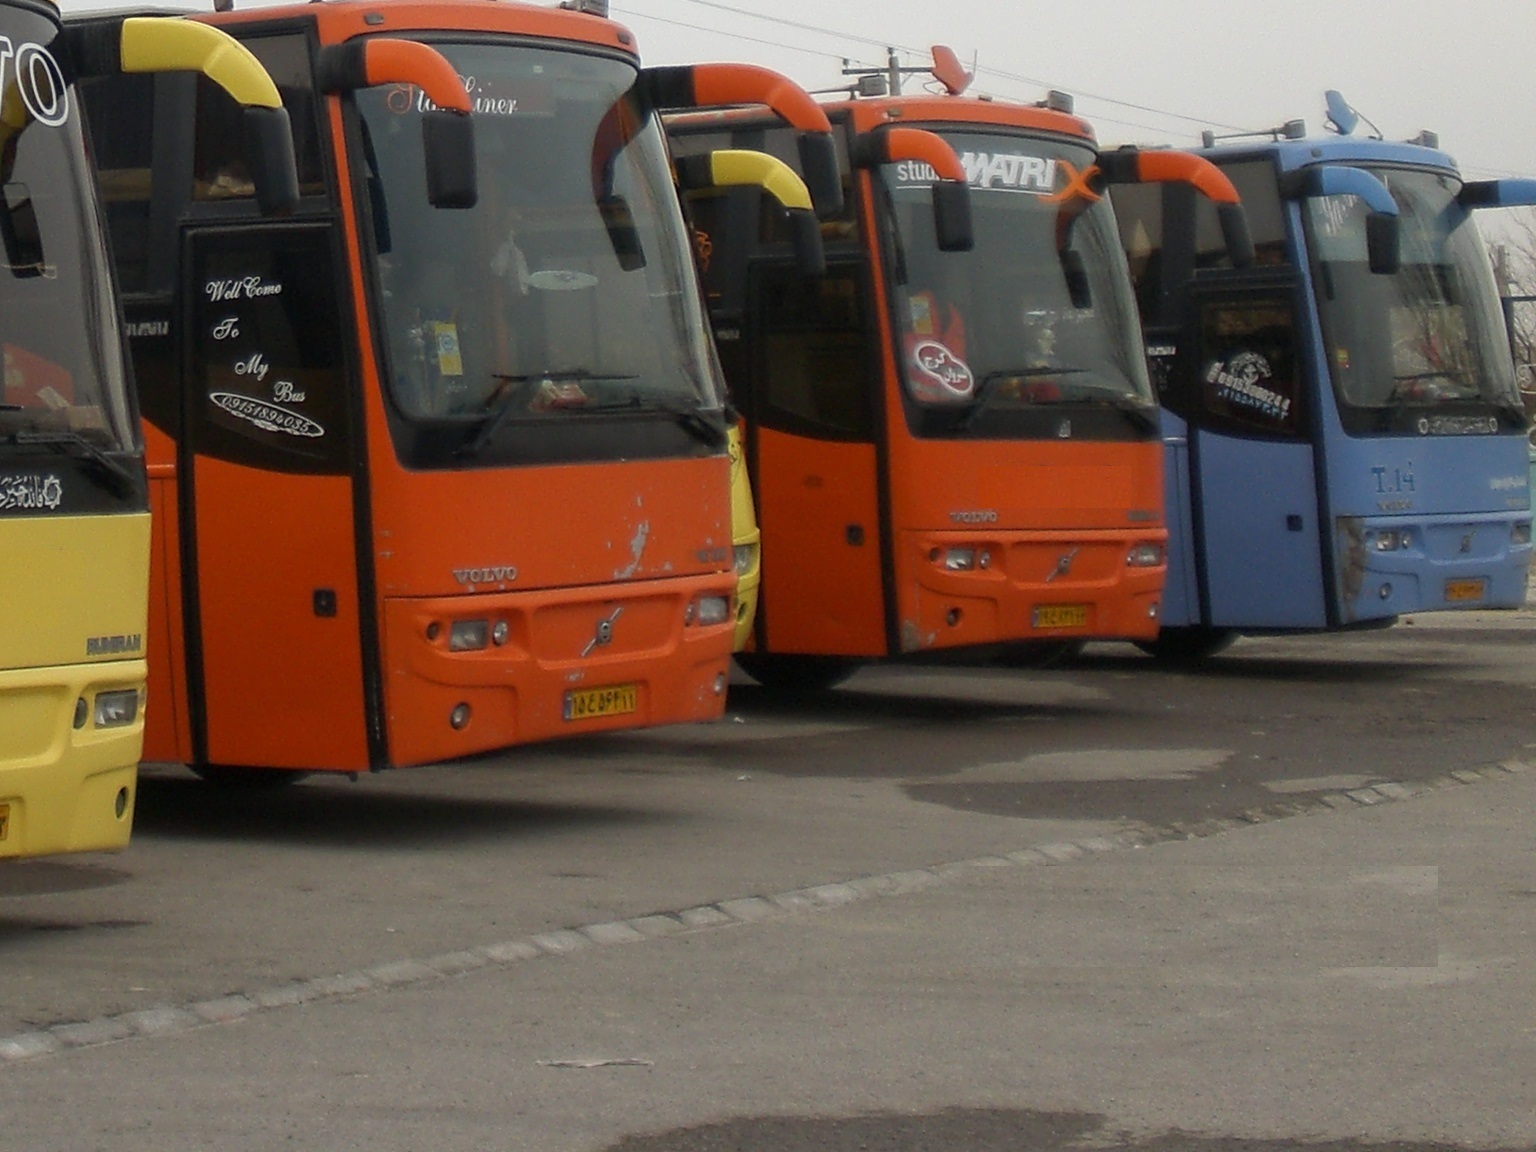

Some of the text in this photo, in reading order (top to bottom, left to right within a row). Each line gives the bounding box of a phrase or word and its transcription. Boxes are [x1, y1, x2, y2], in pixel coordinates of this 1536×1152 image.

[213, 317, 240, 340] To
[234, 354, 269, 381] My
[274, 381, 306, 402] Bus
[452, 566, 517, 585] VOLVO
